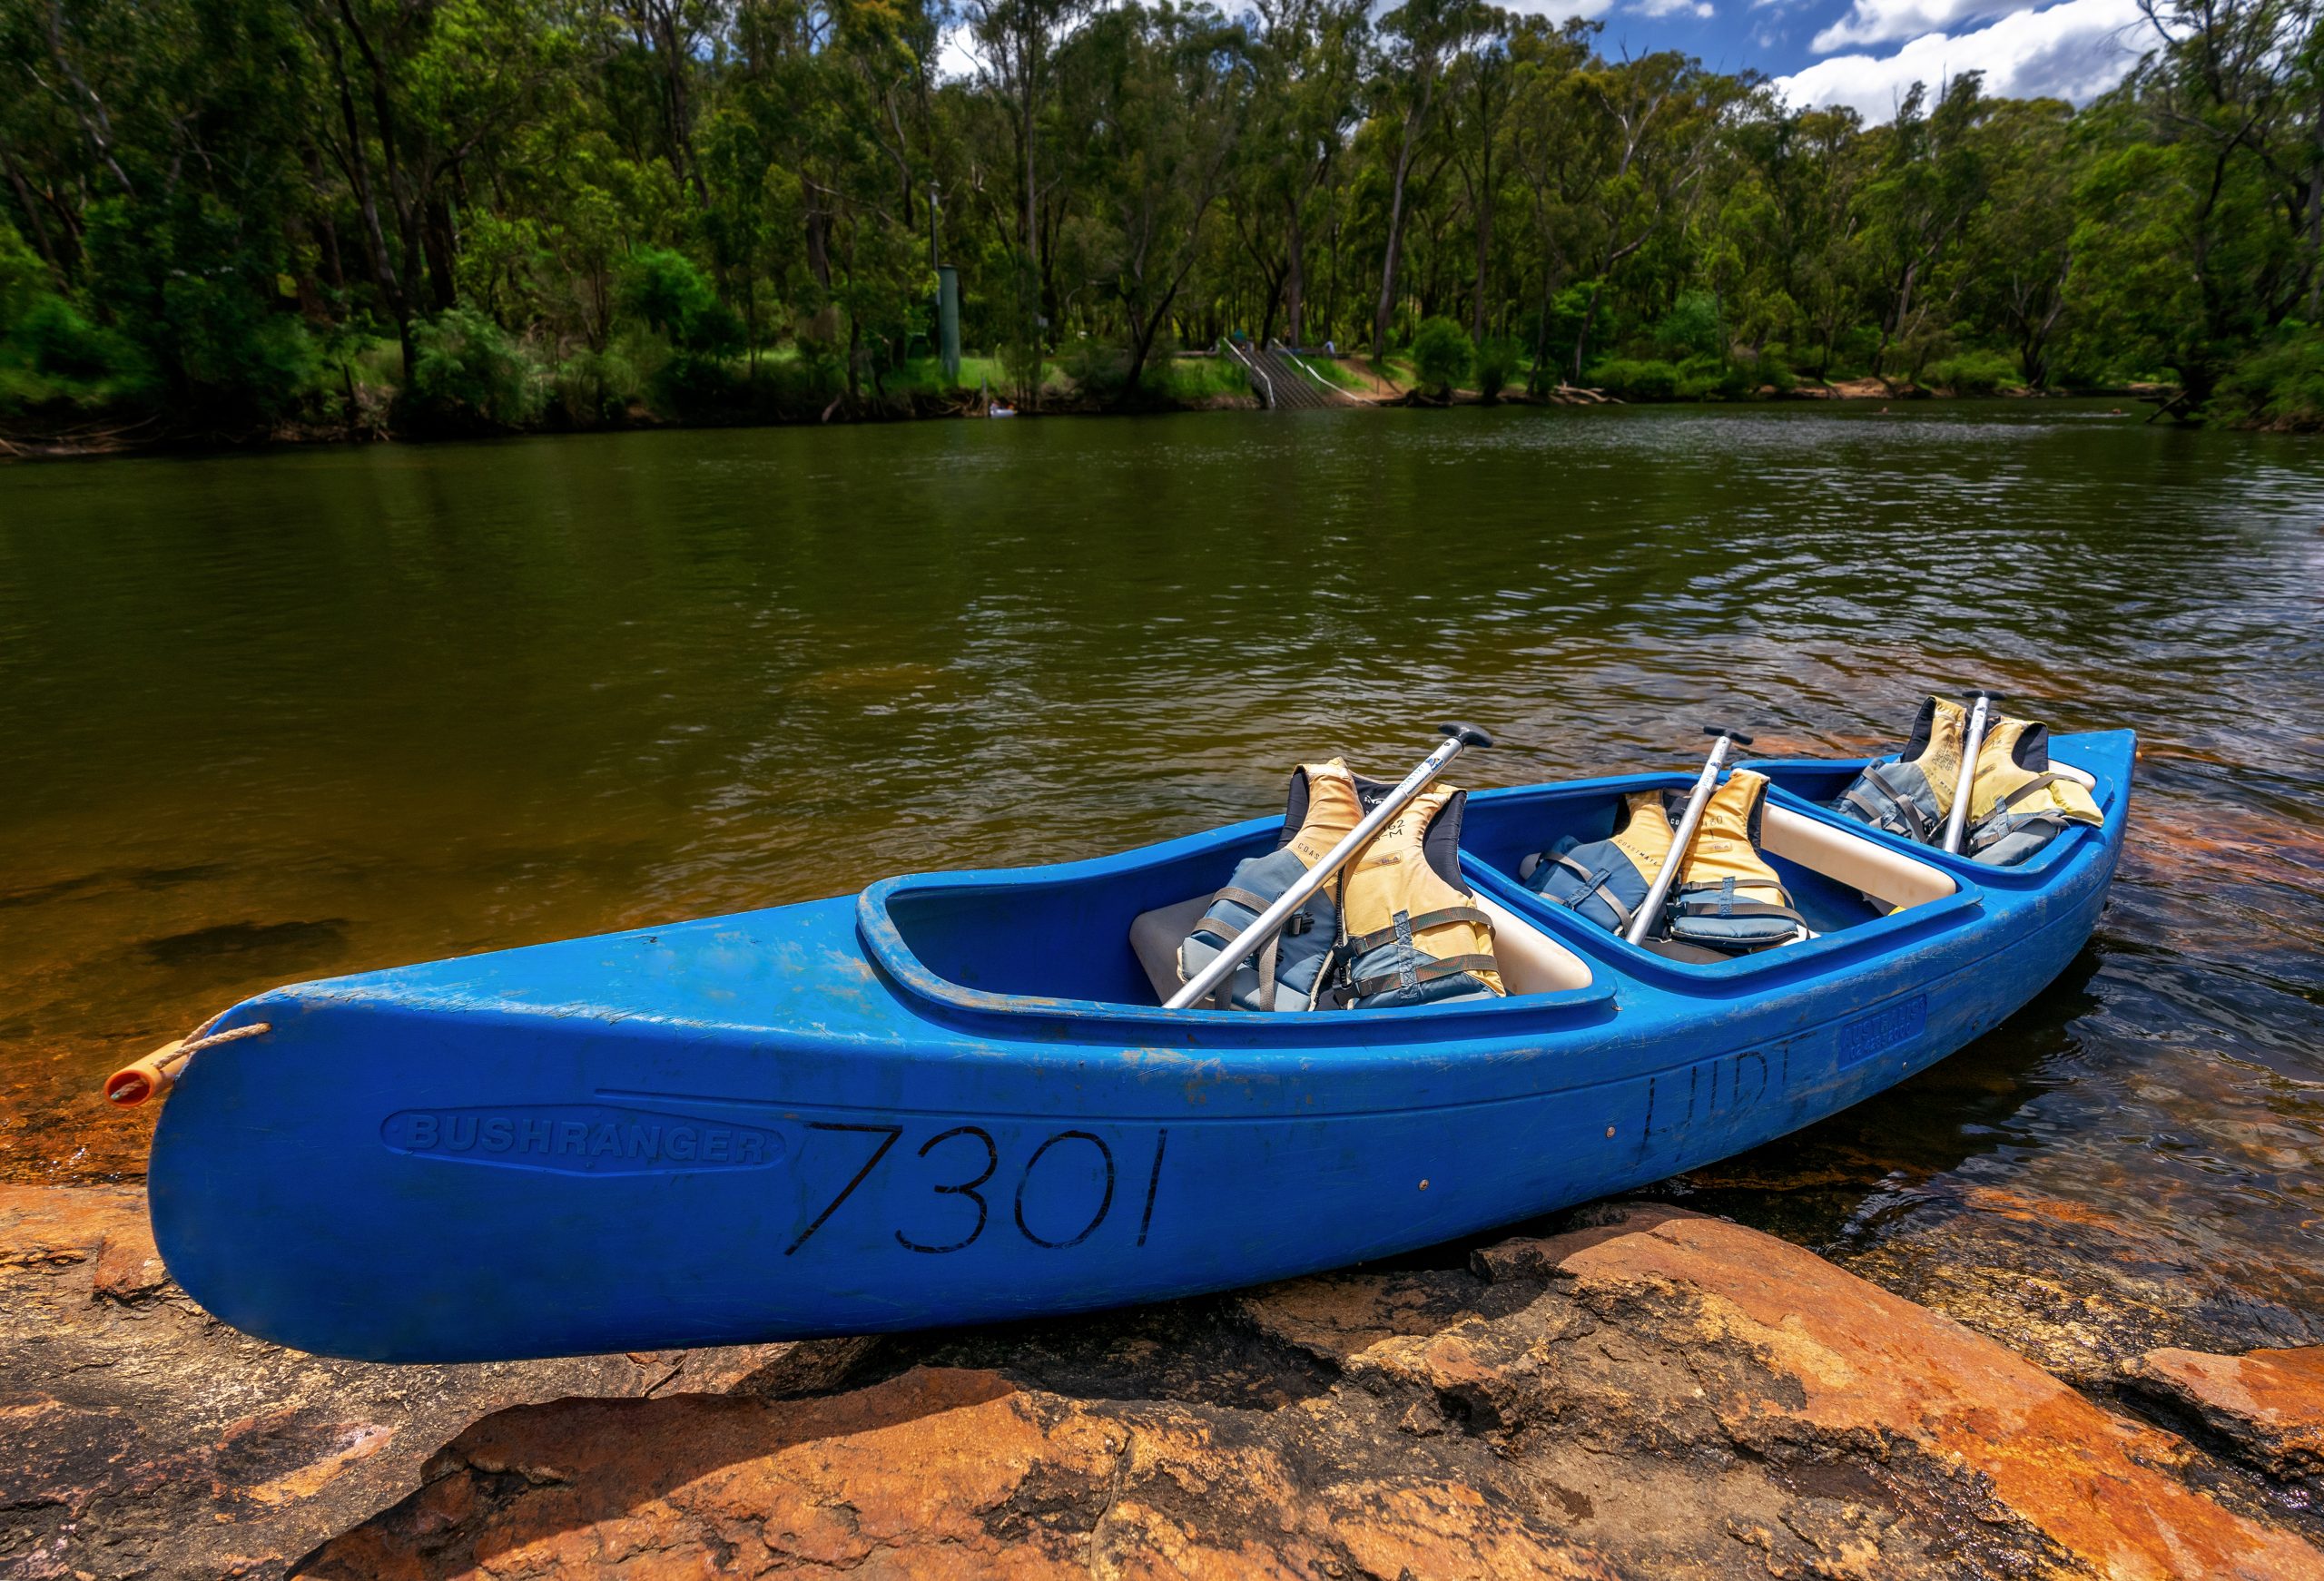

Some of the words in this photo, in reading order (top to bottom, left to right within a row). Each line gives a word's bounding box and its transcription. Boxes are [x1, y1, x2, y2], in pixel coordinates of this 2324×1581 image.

[1297, 842, 1324, 860] COAS
[405, 1113, 769, 1164] BUSHRANGER
[783, 1121, 1168, 1257] 7301
